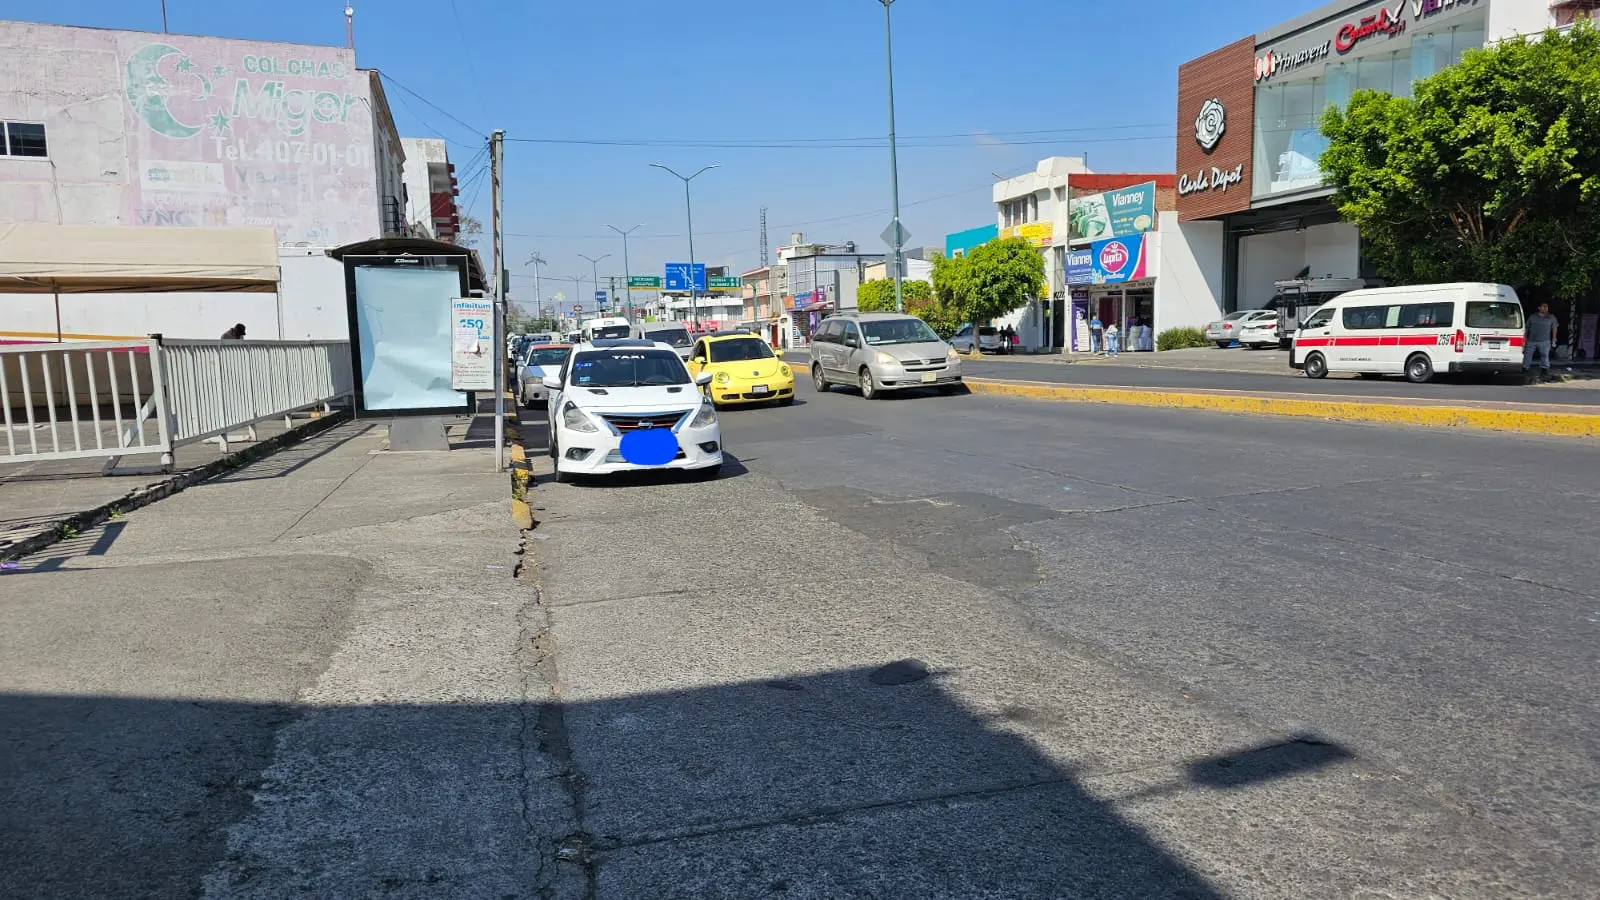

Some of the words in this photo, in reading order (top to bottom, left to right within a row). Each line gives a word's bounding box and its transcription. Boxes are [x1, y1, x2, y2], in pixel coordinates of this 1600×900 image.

[1274, 40, 1332, 69] Primavera
[242, 54, 346, 79] COLCHAS
[1179, 169, 1209, 195] Carla
[1211, 163, 1242, 192] Depot
[1112, 191, 1145, 207] Vianney
[1066, 254, 1093, 266] Vianney
[1103, 252, 1122, 265] Lupita
[1438, 333, 1450, 346] 259
[1468, 333, 1480, 346] 259
